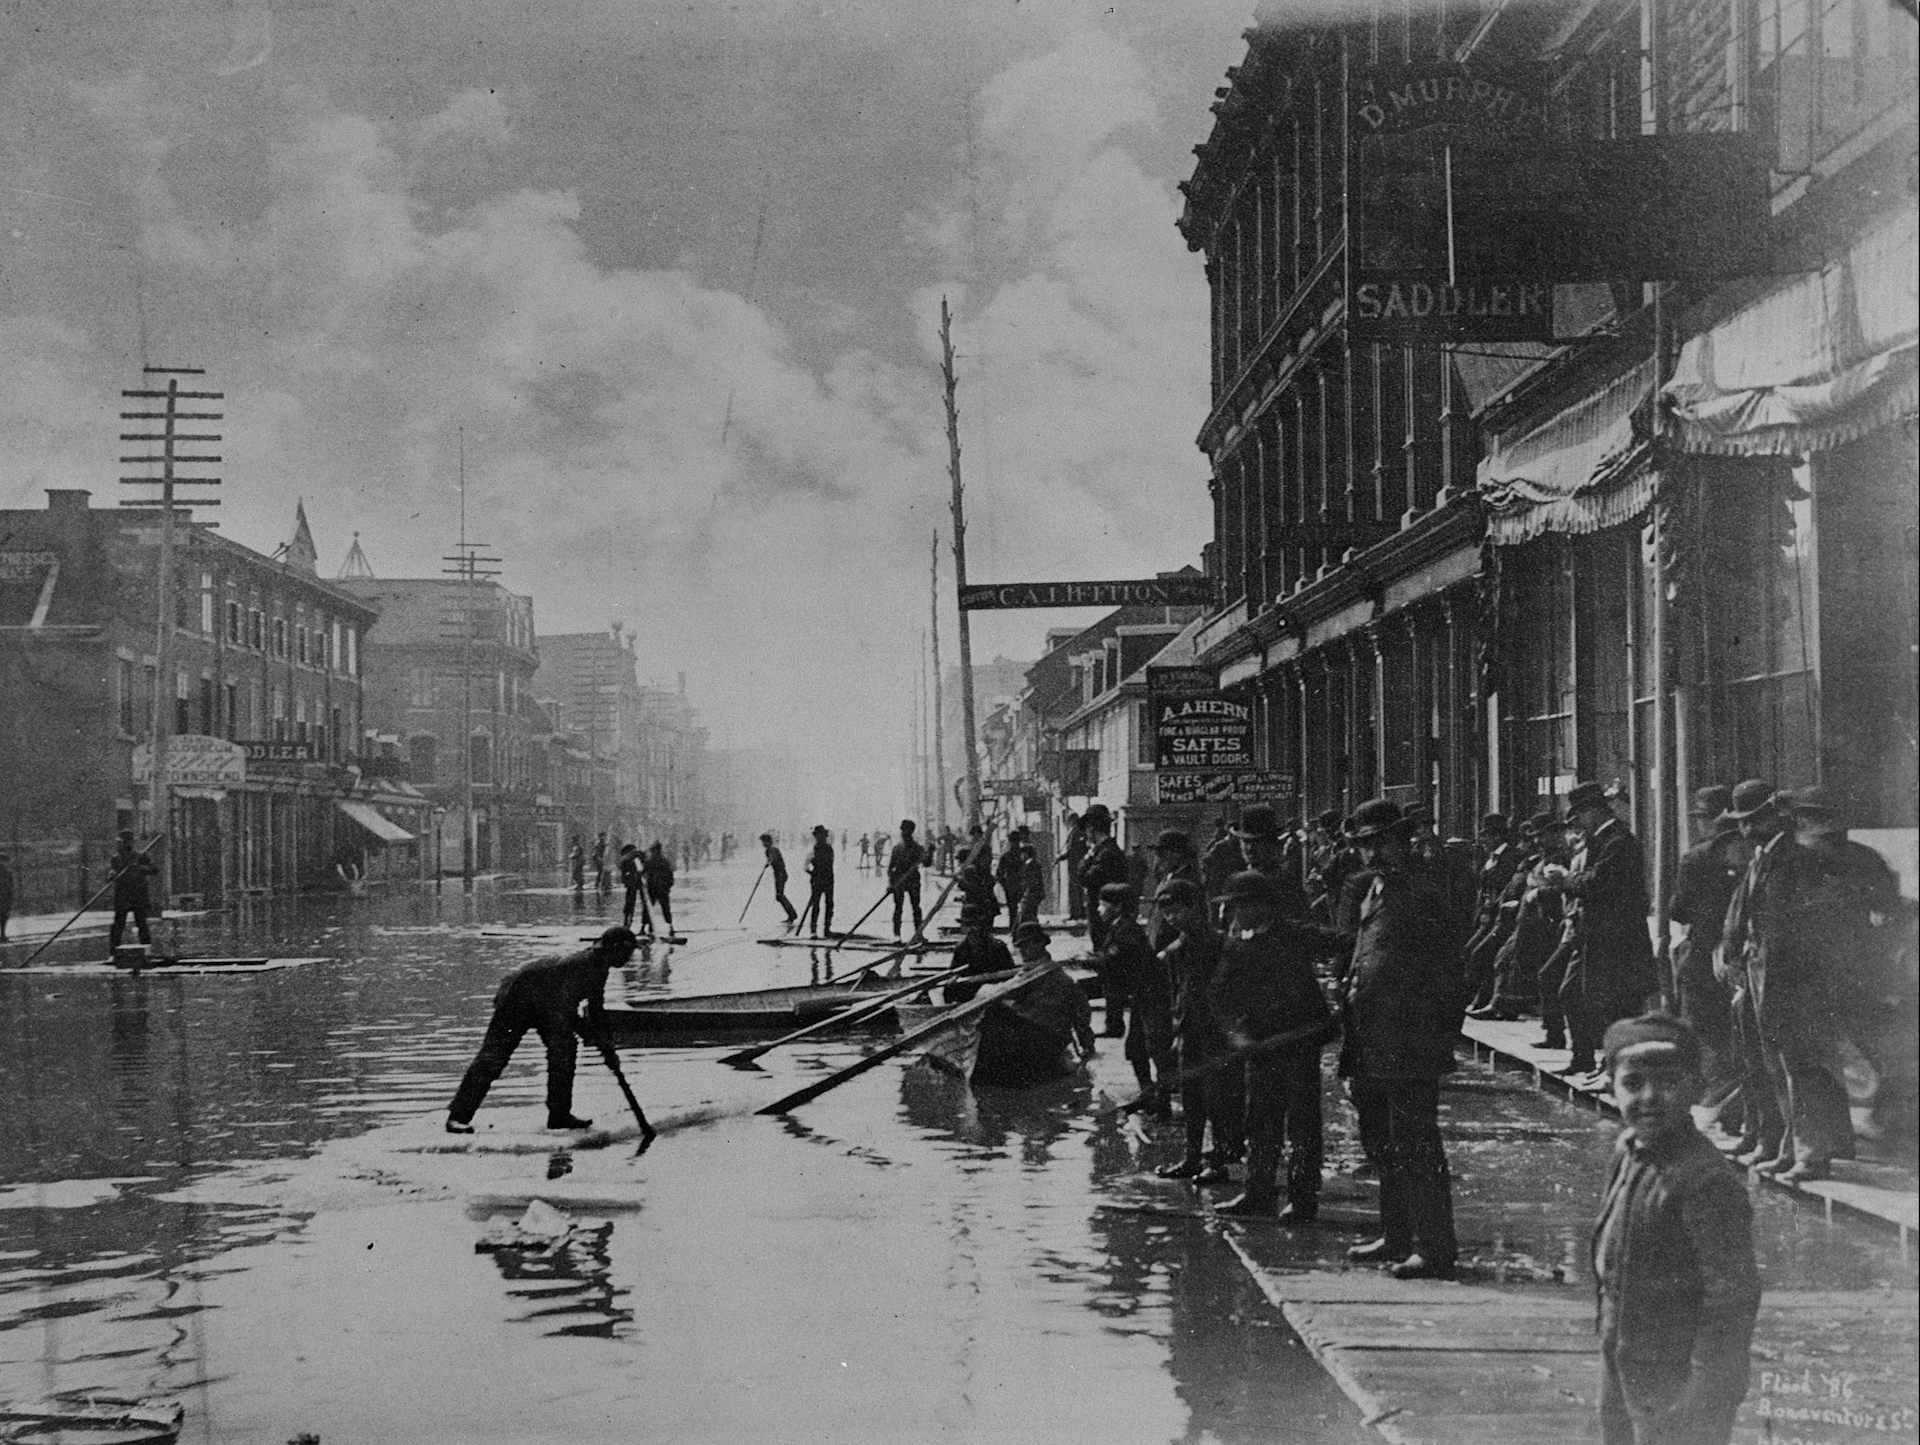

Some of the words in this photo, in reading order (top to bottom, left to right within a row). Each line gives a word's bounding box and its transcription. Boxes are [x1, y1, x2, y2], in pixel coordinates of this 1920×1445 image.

[1356, 283, 1544, 318] SADDLER
[1180, 700, 1250, 720] AHERN
[1172, 737, 1242, 752] SAFES
[1161, 755, 1169, 765] &
[1172, 754, 1207, 765] VAULT
[1212, 753, 1250, 765] DOORS
[1160, 775, 1202, 788] SAFES
